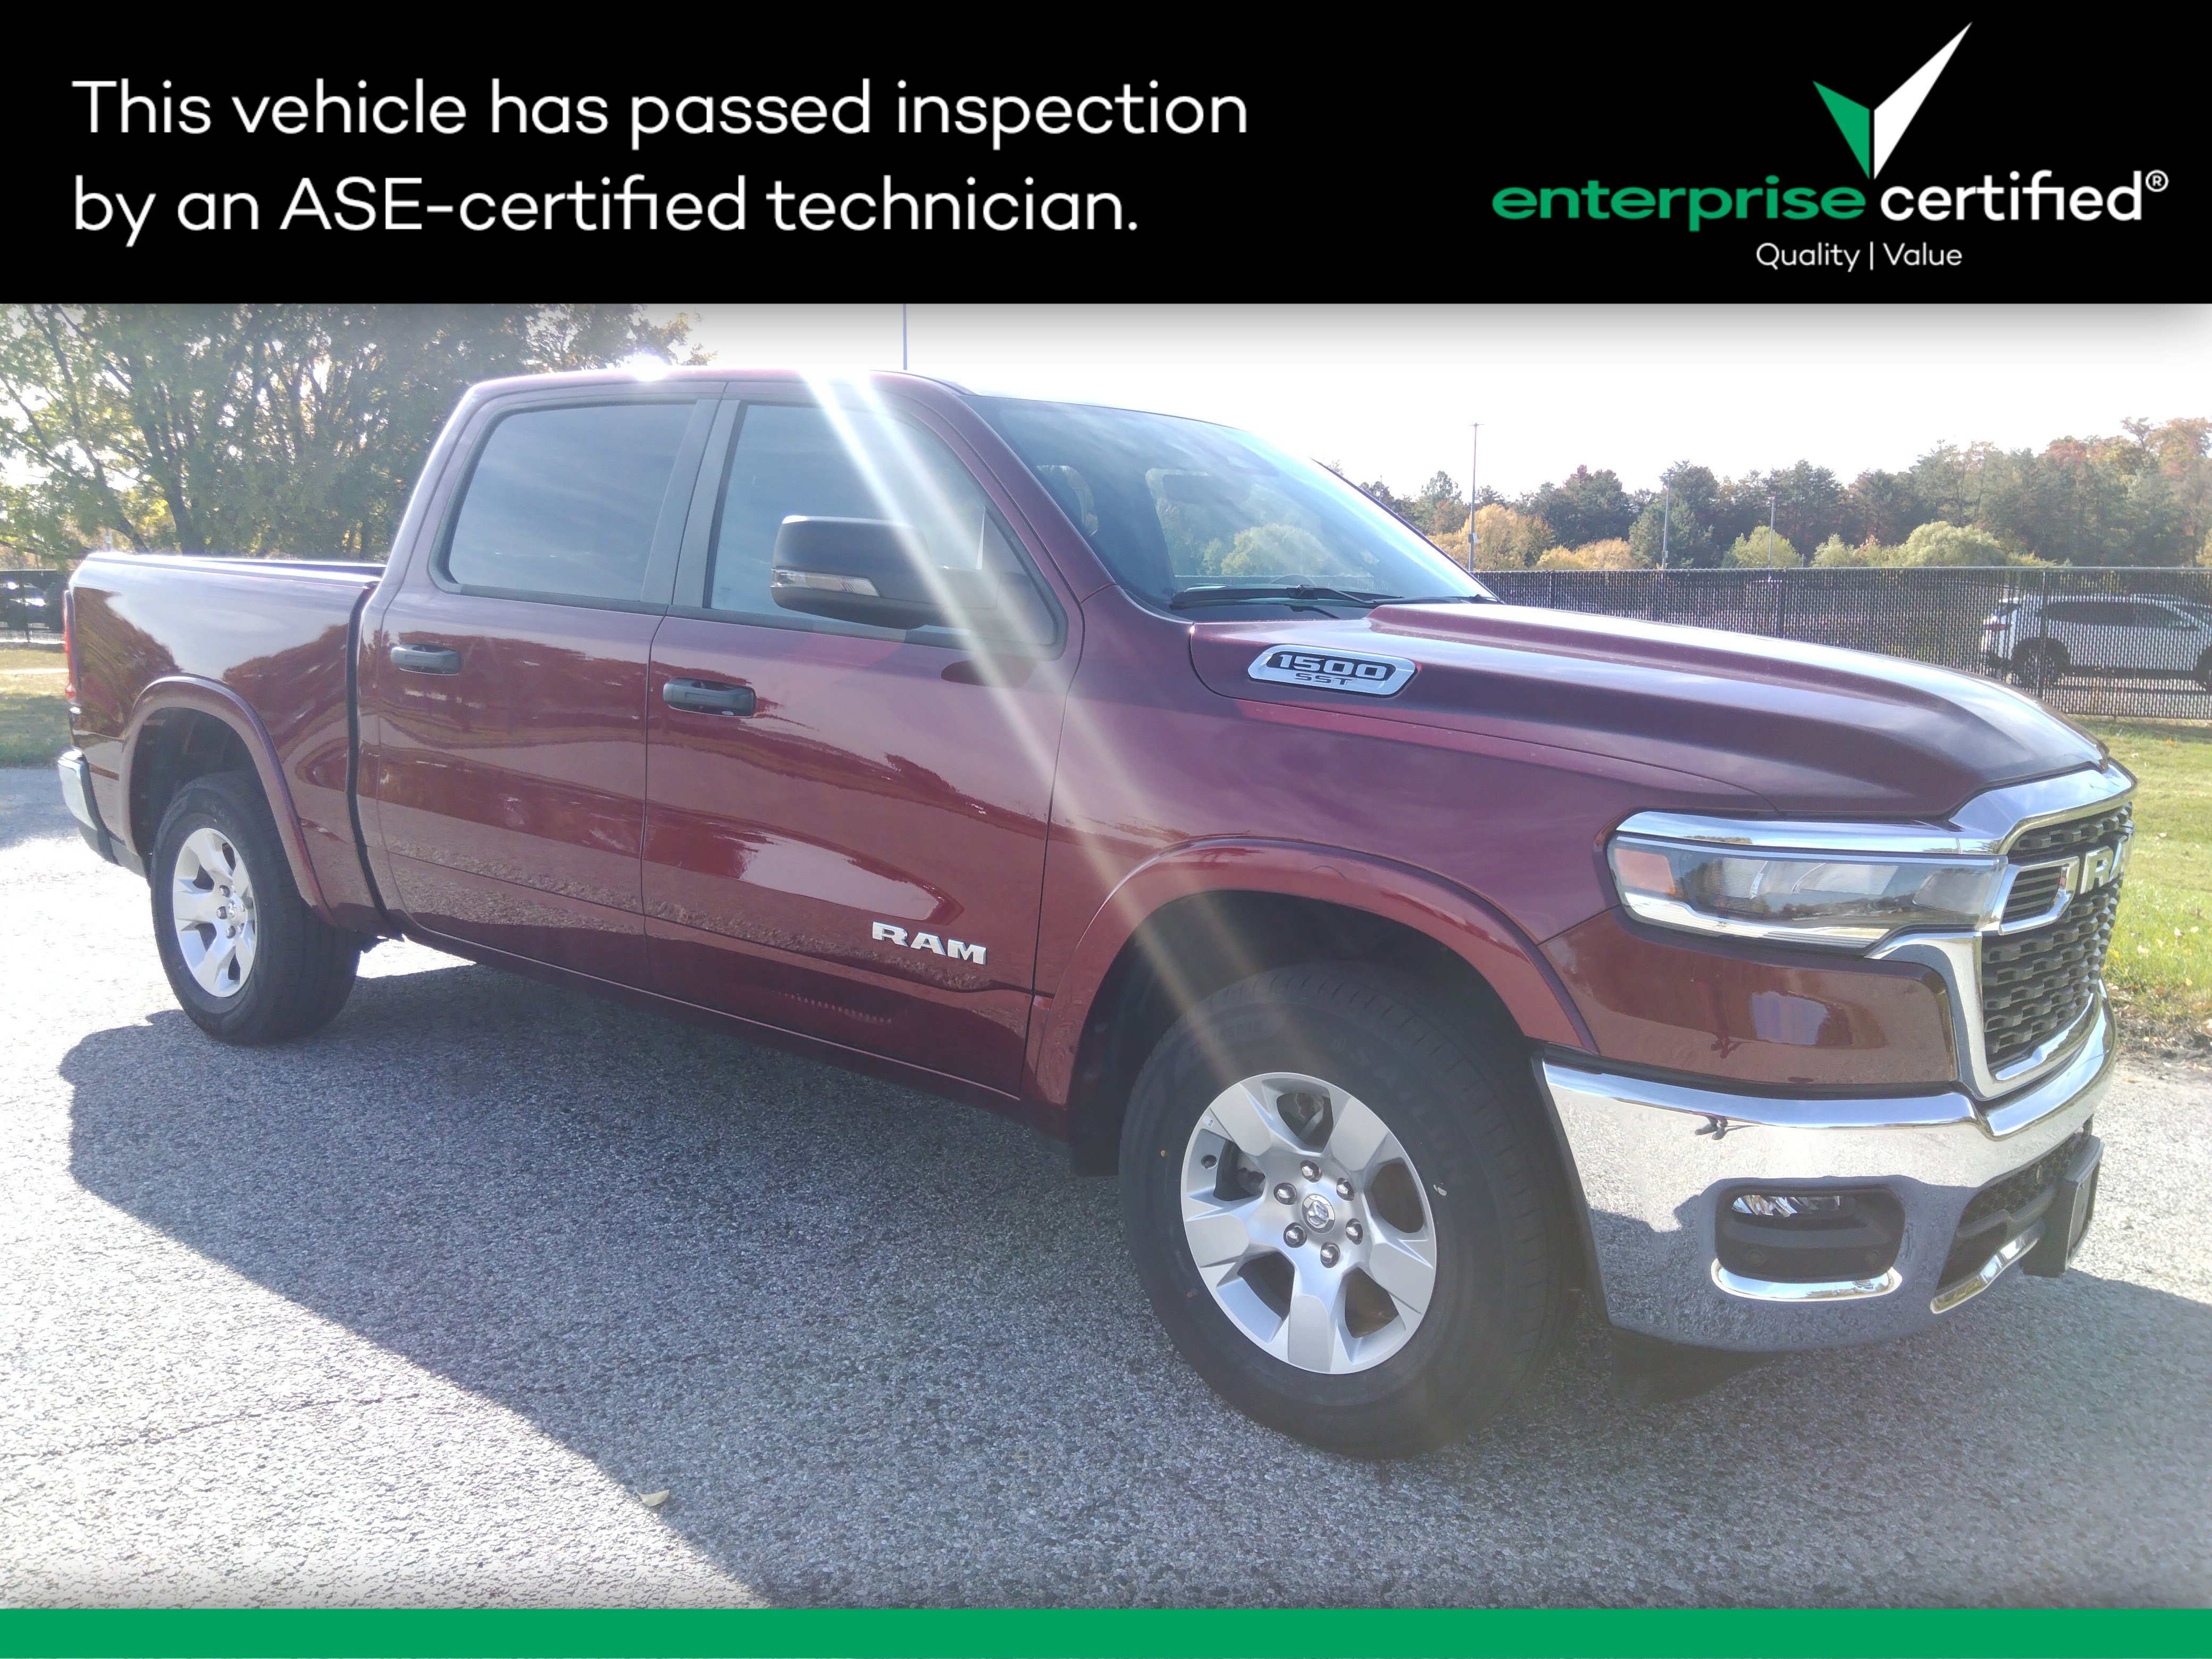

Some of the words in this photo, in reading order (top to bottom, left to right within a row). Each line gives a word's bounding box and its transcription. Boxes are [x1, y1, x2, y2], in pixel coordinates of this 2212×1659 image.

[1279, 653, 1387, 680] 1500
[1294, 672, 1355, 686] SST
[872, 921, 987, 965] RAM
